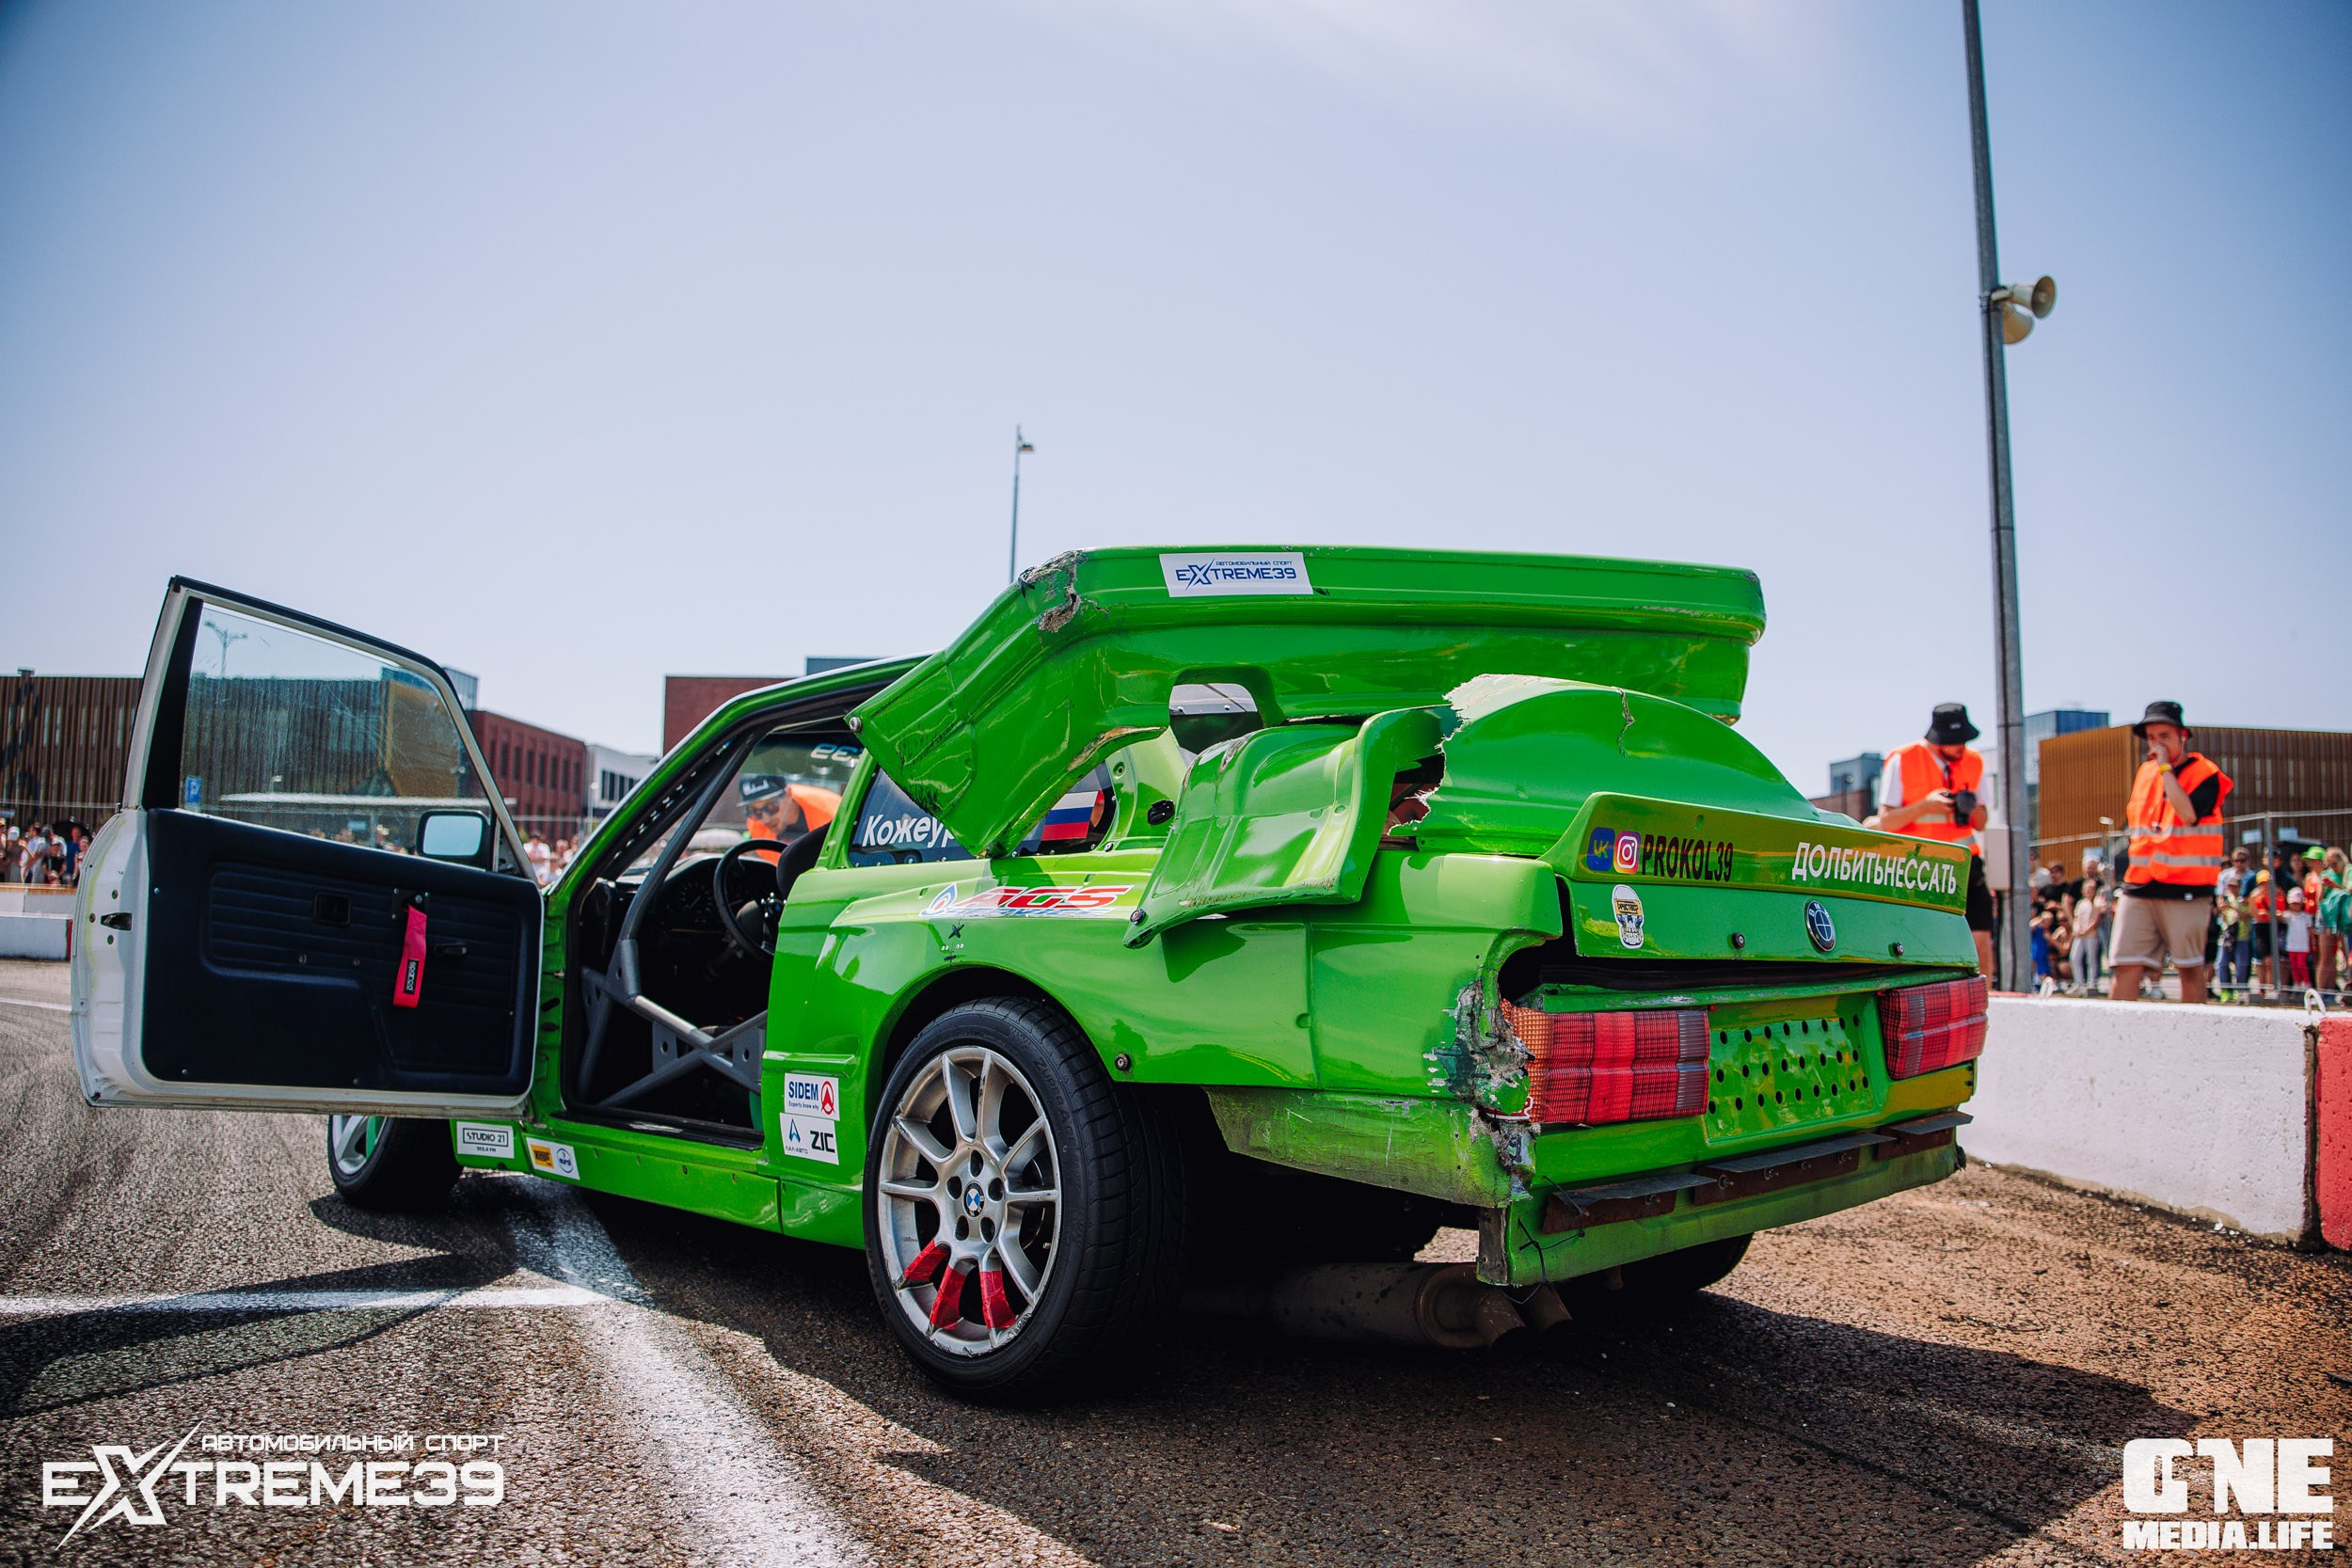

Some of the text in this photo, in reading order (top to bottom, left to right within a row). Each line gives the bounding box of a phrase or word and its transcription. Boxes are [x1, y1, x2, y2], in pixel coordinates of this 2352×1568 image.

[1175, 558, 1296, 592] EXTREME39
[1642, 833, 1734, 882] PROKOL39
[1791, 841, 1957, 895] ДОЛБИТЬНЕССАТЬ
[952, 885, 1136, 909] AGS
[788, 1081, 818, 1101] SIDEM
[467, 1132, 505, 1144] STUDIO 21
[810, 1130, 835, 1153] ZIC
